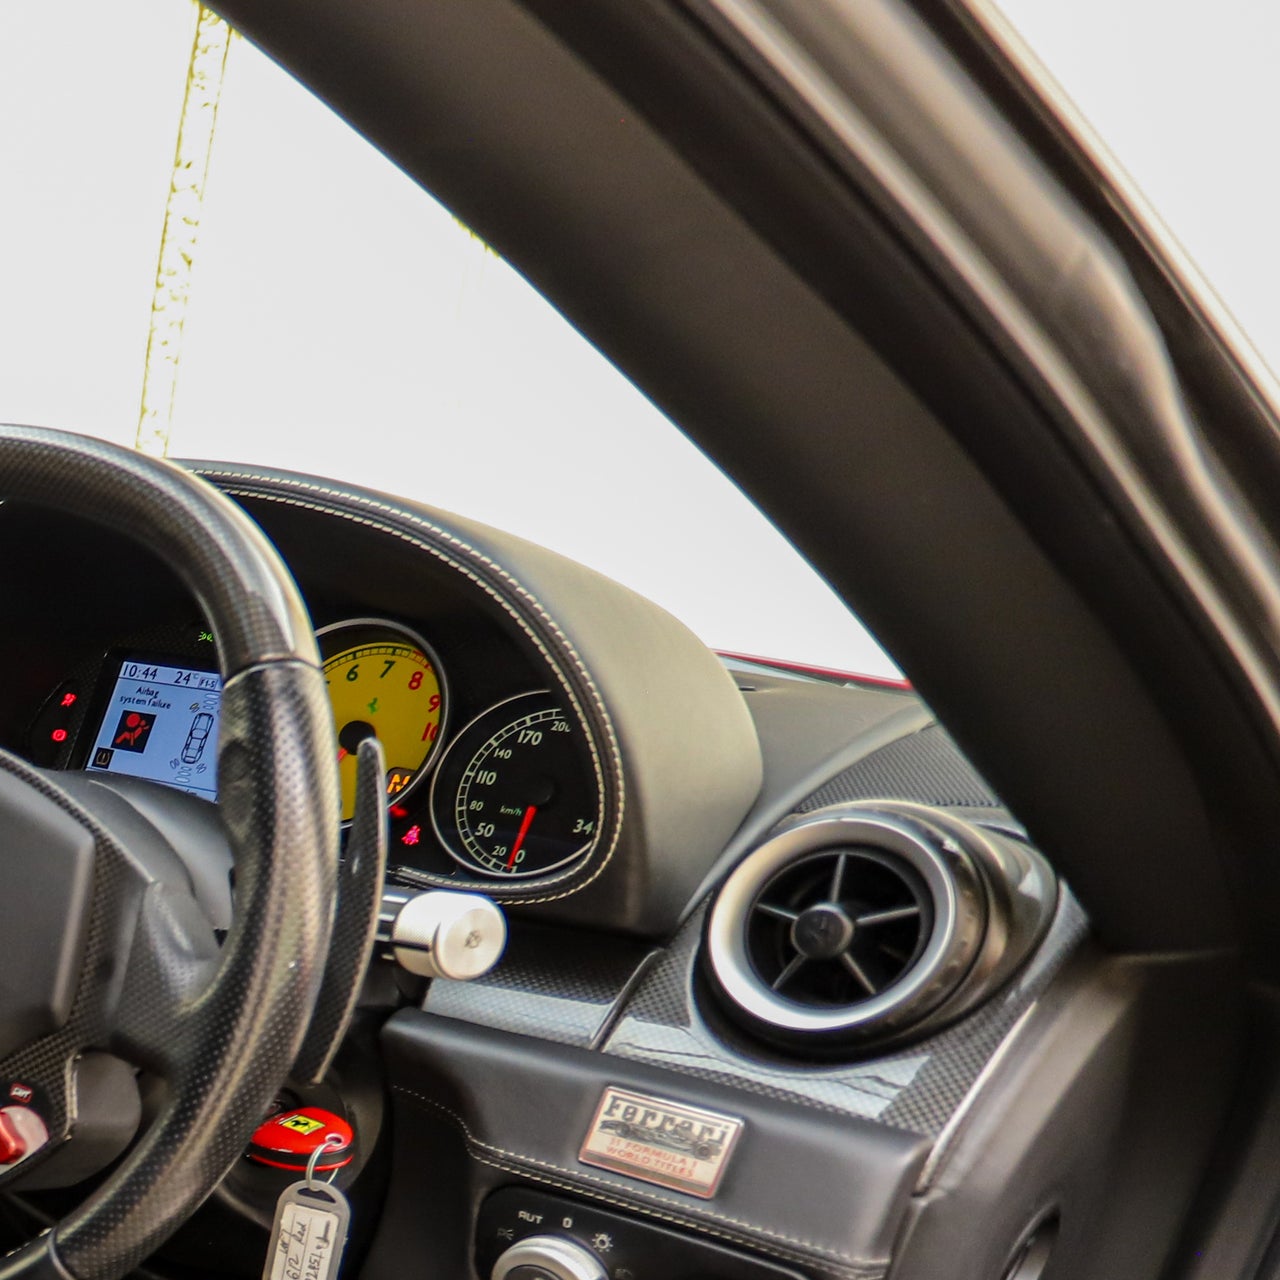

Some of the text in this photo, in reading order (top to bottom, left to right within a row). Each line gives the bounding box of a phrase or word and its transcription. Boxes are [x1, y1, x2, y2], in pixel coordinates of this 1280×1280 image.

[123, 663, 158, 680] 10:44
[346, 664, 359, 681] 6
[380, 660, 396, 679] 7
[408, 671, 423, 690] 8
[136, 686, 159, 699] Airbag
[120, 695, 171, 709] system failure
[428, 694, 440, 712] 9
[517, 730, 543, 746] 170
[493, 748, 512, 760] 140
[387, 774, 411, 793] N
[475, 770, 497, 785] 110
[469, 801, 484, 811] 80
[499, 806, 522, 816] km/h
[475, 822, 495, 838] 50
[573, 819, 595, 835] 34
[491, 845, 507, 857] 20
[514, 849, 525, 864] 0
[604, 1095, 730, 1144] Ferrari
[607, 1146, 695, 1177] WORLD TITLES
[625, 1142, 687, 1165] FORMULA
[518, 1211, 543, 1224] AUT
